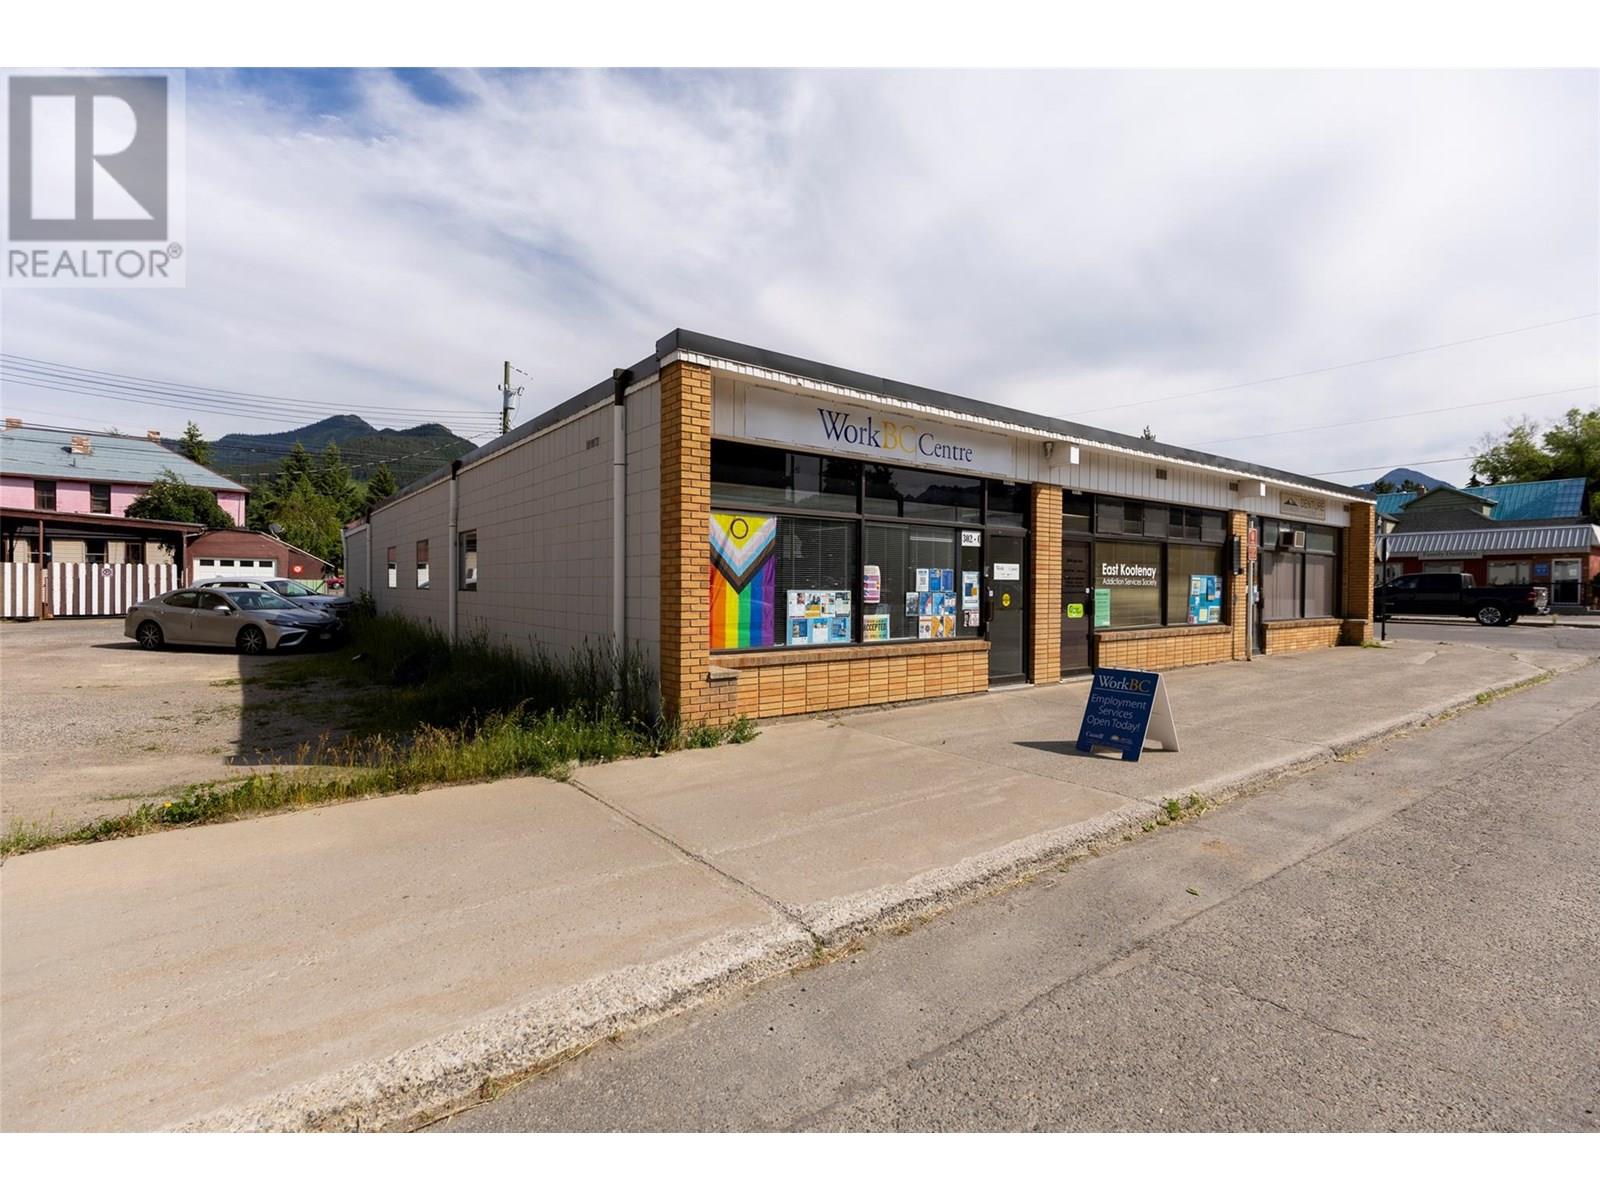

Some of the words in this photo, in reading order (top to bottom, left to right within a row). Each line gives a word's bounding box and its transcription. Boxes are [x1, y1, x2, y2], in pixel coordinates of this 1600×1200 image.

[817, 407, 916, 454] WorkBC
[918, 432, 974, 463] Centre
[1102, 562, 1119, 576] East
[1120, 563, 1157, 580] Kootenay
[1102, 577, 1125, 585] Addiction
[1125, 578, 1142, 586] Services
[1142, 578, 1157, 587] Society
[1098, 674, 1152, 693] WorkBC
[1090, 693, 1147, 710] Employment
[1098, 705, 1134, 720] Services
[1086, 714, 1111, 728] Open
[1111, 718, 1141, 733] Today!
